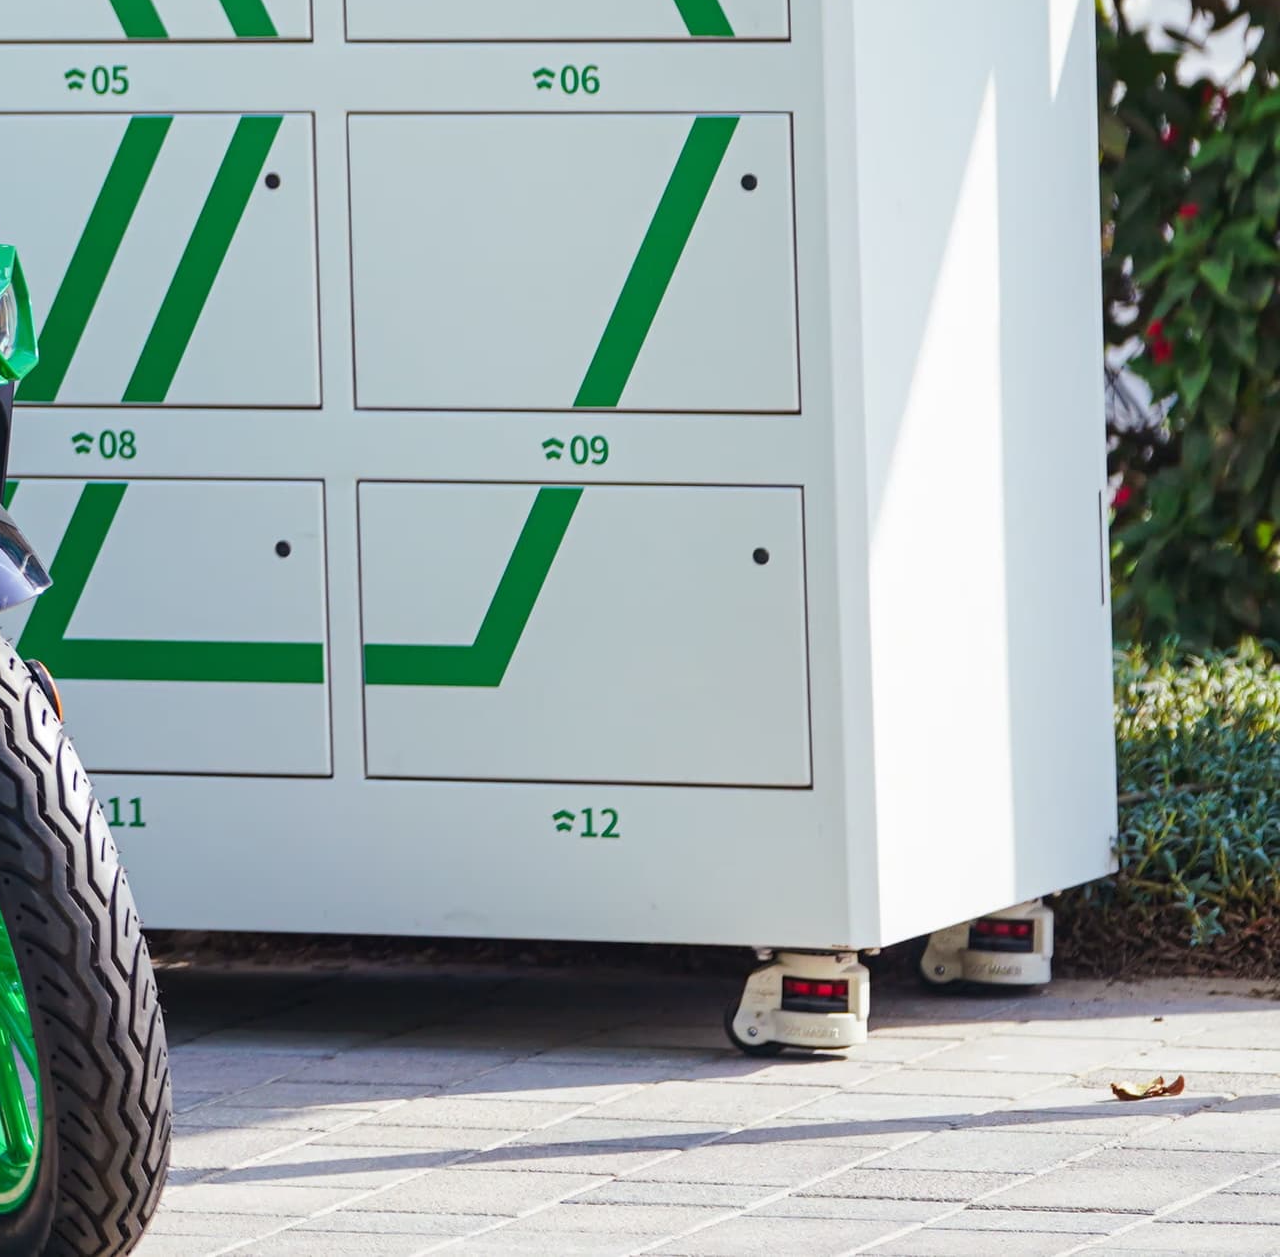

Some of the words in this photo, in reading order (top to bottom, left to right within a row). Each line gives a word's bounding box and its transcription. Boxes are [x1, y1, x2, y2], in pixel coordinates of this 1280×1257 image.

[90, 64, 130, 97] 05
[559, 63, 601, 96] 06
[97, 429, 138, 461] 08
[568, 434, 610, 467] 09
[108, 797, 146, 828] 11
[580, 807, 621, 839] 12
